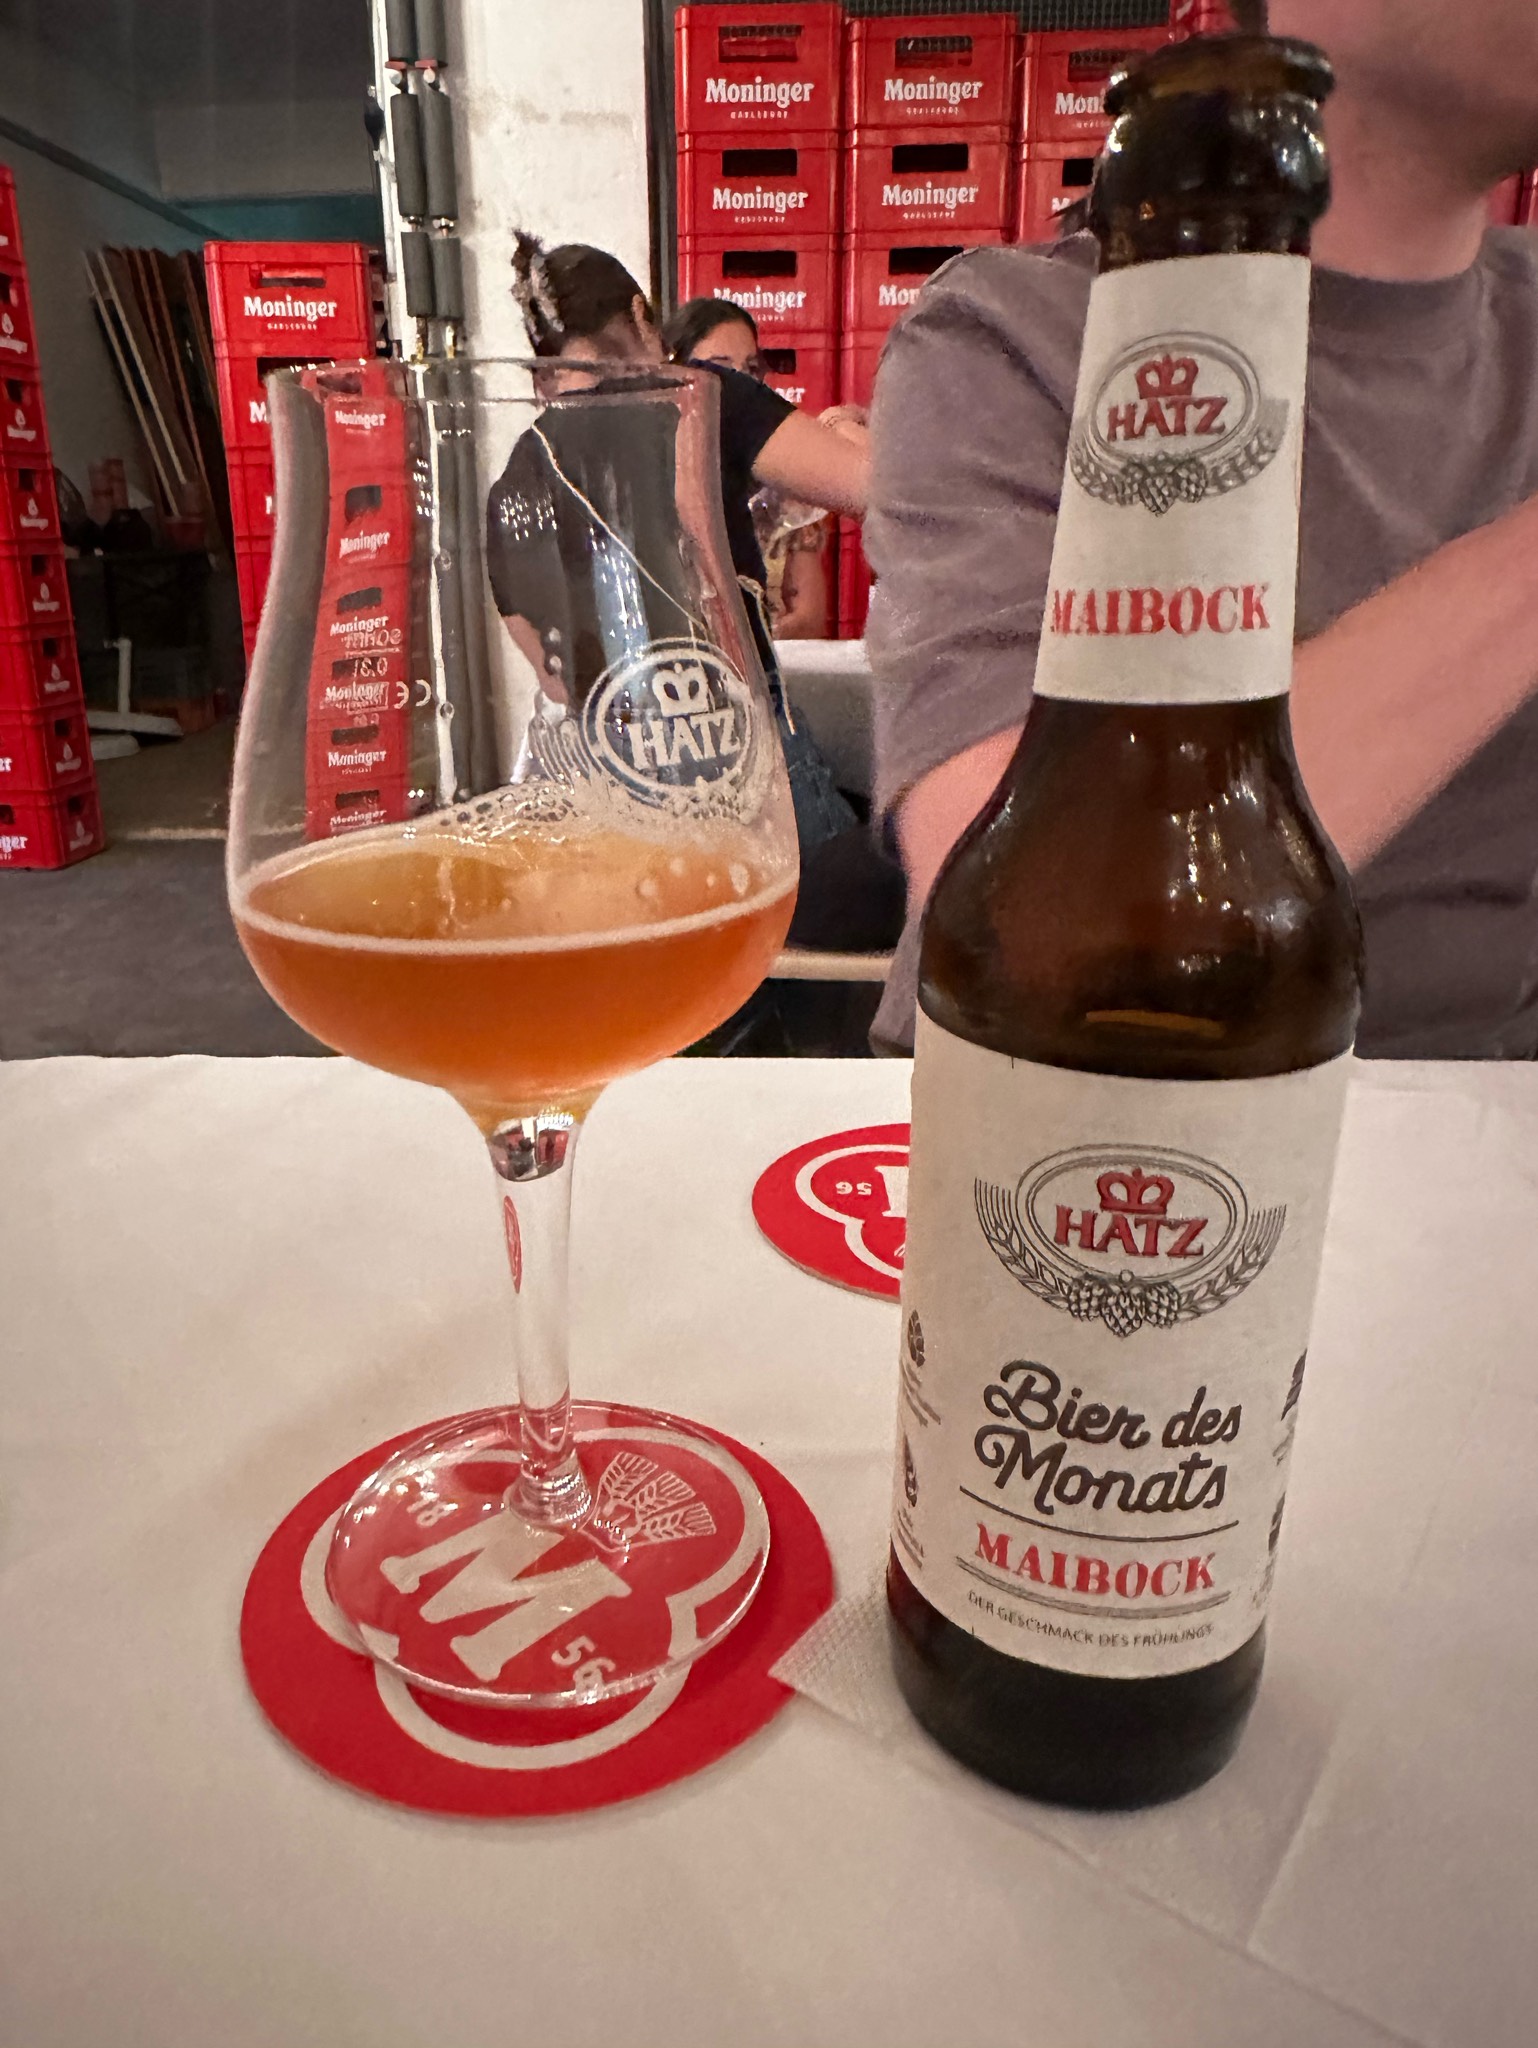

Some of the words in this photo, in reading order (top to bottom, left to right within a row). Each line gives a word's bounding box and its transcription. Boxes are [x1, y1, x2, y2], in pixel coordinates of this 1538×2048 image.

[705, 77, 815, 109] Moninger
[884, 75, 984, 103] Moninger
[712, 185, 808, 213] Moninger
[881, 181, 979, 209] Moninger
[243, 294, 338, 322] Moninger
[1106, 395, 1229, 442] HATZ
[329, 615, 389, 637] Moninger
[1050, 581, 1271, 637] MAIBOCK
[627, 708, 741, 771] HATZ
[1054, 1204, 1209, 1258] HATZ
[983, 1359, 1151, 1449] Bier
[1162, 1385, 1242, 1448] des
[974, 1424, 1228, 1515] Monats
[975, 1521, 1216, 1598] MAIBOCK
